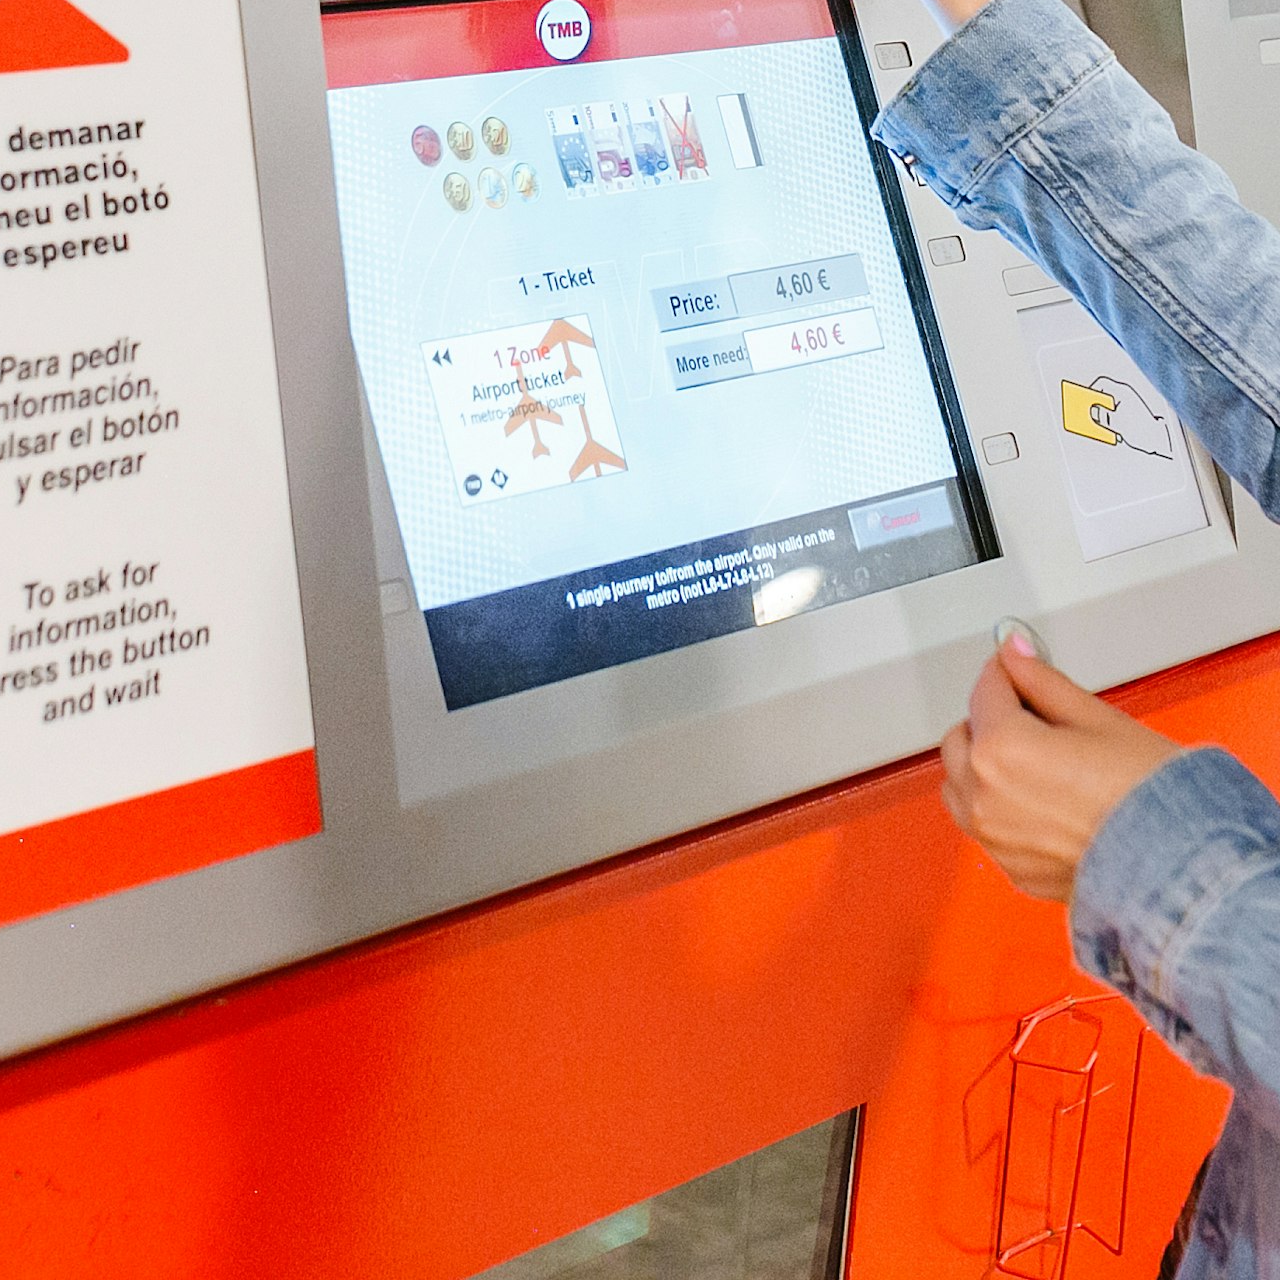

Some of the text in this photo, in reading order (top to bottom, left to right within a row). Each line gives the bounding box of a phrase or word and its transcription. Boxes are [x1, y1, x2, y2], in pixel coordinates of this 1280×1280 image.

[548, 20, 583, 40] TMB
[8, 119, 146, 152] demanar
[65, 194, 90, 221] el
[103, 182, 170, 217] botó
[4, 232, 130, 268] espereu
[519, 267, 595, 295] 1 Ticket
[670, 269, 831, 317] Price: 4,60 €
[0, 336, 141, 384] Para pedir
[494, 345, 551, 368] 1 Zone
[676, 323, 845, 373] More need: 4,60 €
[472, 370, 565, 402] Airport ticket
[70, 418, 92, 447] el
[104, 405, 179, 442] botón
[460, 391, 586, 427] 1 metro-airport journey
[16, 452, 146, 505] y esperar
[881, 511, 920, 531] Cancel
[24, 560, 159, 610] To ask for
[566, 591, 575, 609] 1
[575, 583, 612, 607] single
[611, 574, 654, 602] journey
[694, 558, 713, 576] the
[713, 548, 752, 571] airport.
[752, 542, 777, 560] Only
[778, 535, 804, 554] valid
[804, 534, 818, 548] on
[819, 527, 835, 544] the
[646, 579, 704, 610] metro (not
[9, 598, 177, 653] information,
[70, 648, 112, 677] the
[123, 625, 210, 665] button
[43, 669, 161, 723] and wait
